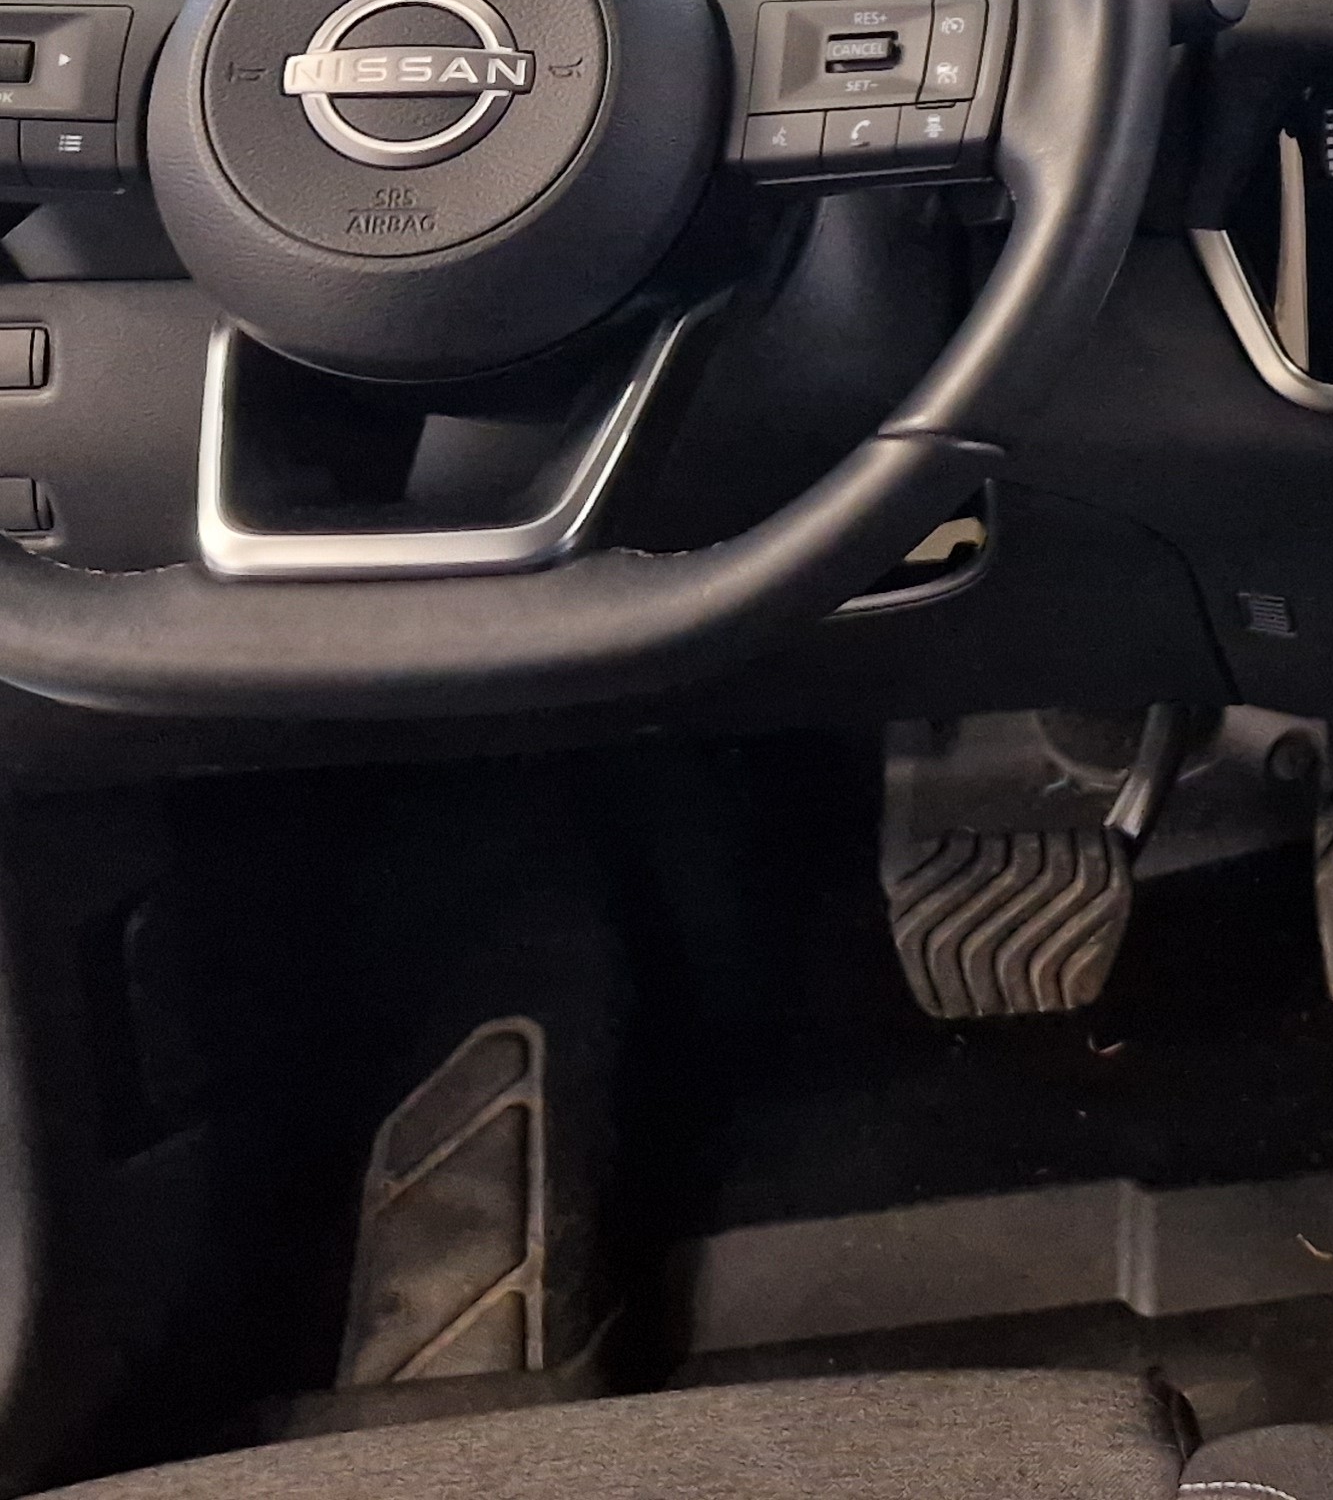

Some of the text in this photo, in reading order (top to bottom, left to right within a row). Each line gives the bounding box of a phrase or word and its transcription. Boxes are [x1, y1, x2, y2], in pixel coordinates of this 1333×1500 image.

[853, 11, 888, 25] RES+
[832, 42, 884, 57] CANCEL
[291, 56, 526, 86] NISSAN
[374, 187, 417, 208] SRS
[345, 213, 438, 235] AIRBAG
